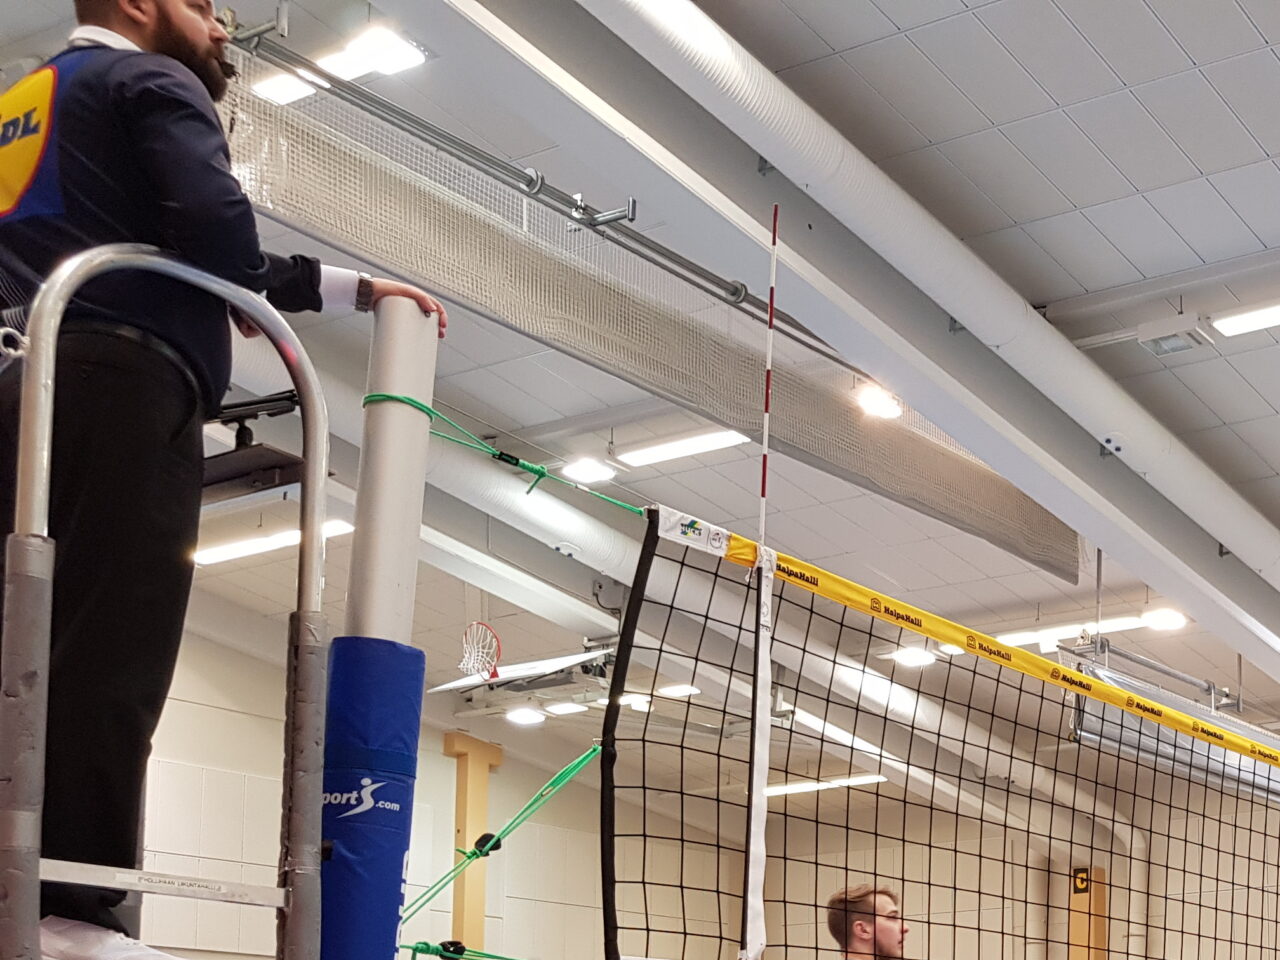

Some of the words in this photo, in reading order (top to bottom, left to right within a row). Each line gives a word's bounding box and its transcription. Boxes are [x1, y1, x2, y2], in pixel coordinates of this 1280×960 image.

[0, 107, 41, 147] DL
[776, 563, 819, 587] HalpaHalli
[883, 606, 922, 627] HalpaHalli
[978, 642, 1012, 662] HalpaHalli
